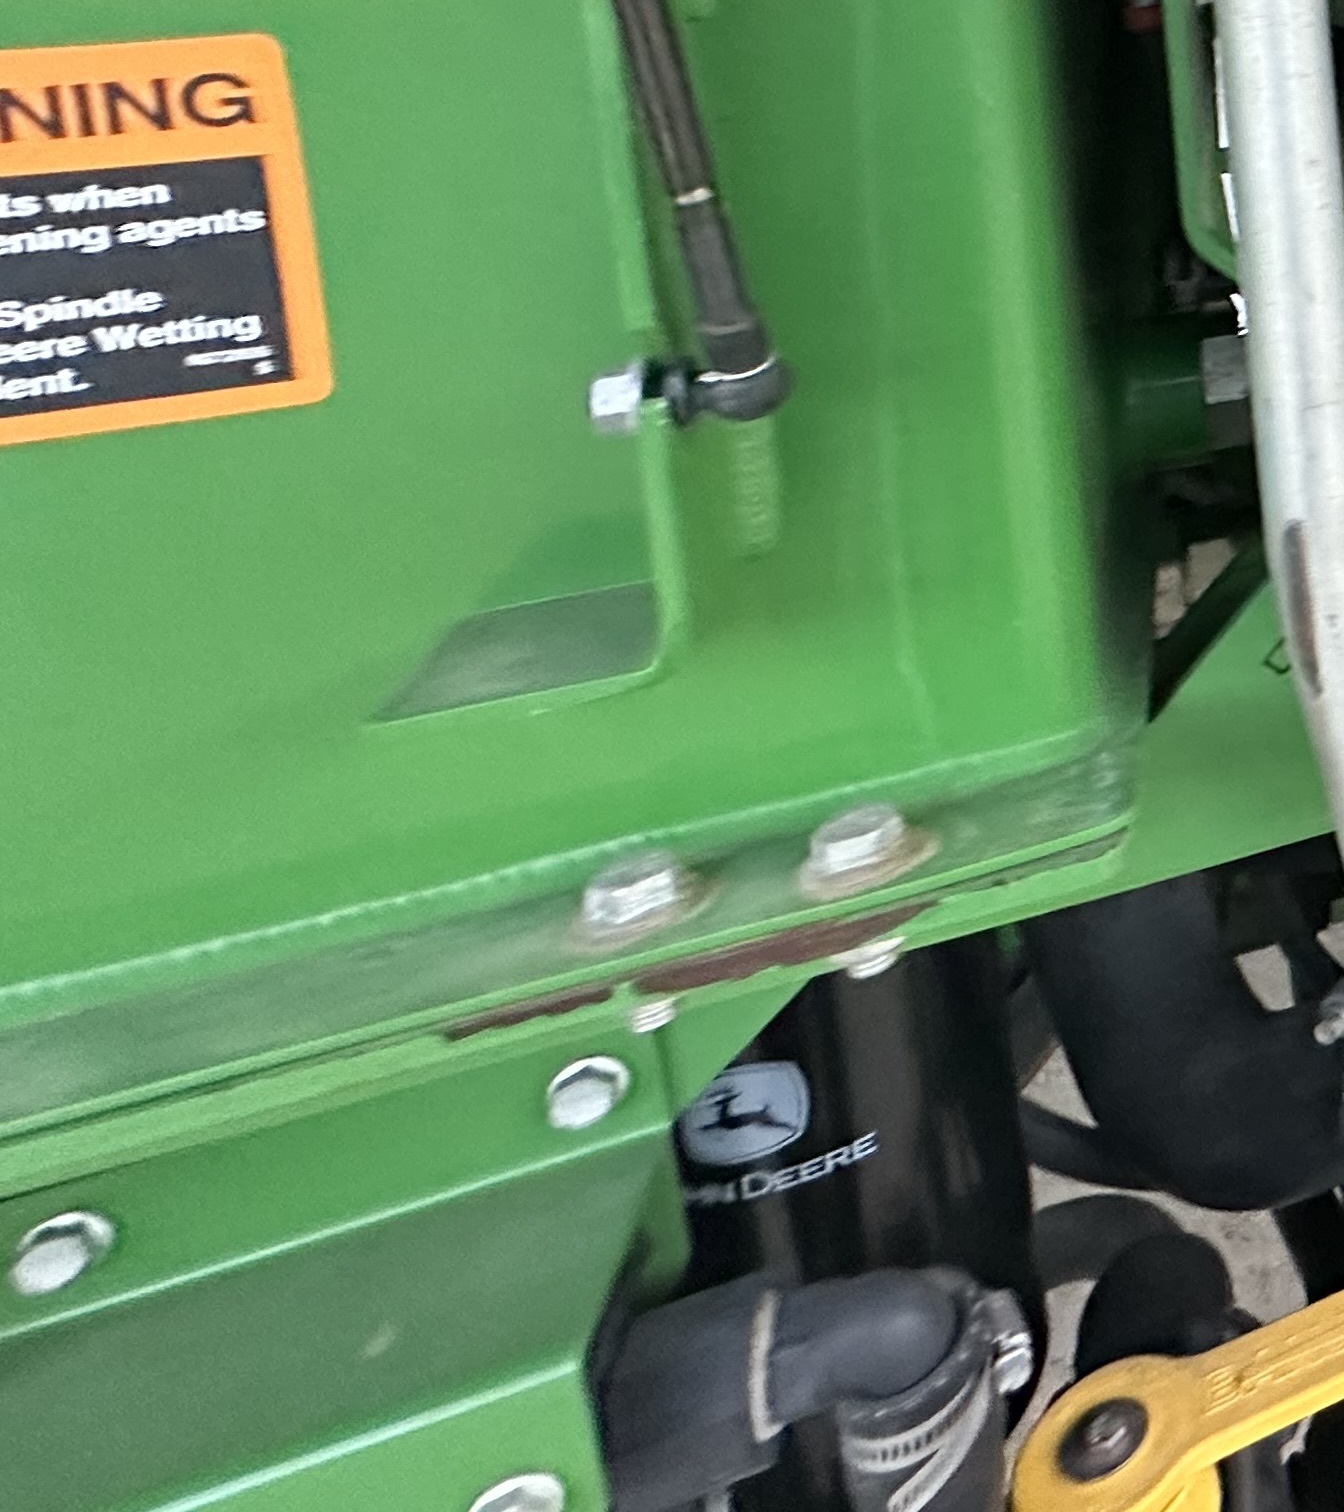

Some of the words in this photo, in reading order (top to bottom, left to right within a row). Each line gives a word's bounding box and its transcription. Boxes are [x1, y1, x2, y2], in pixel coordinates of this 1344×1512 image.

[0, 72, 257, 143] NING
[46, 184, 171, 213] when
[116, 209, 267, 248] agents
[0, 289, 167, 332] Spindle
[90, 315, 263, 353] Wetting
[741, 1130, 879, 1200] DEERE
